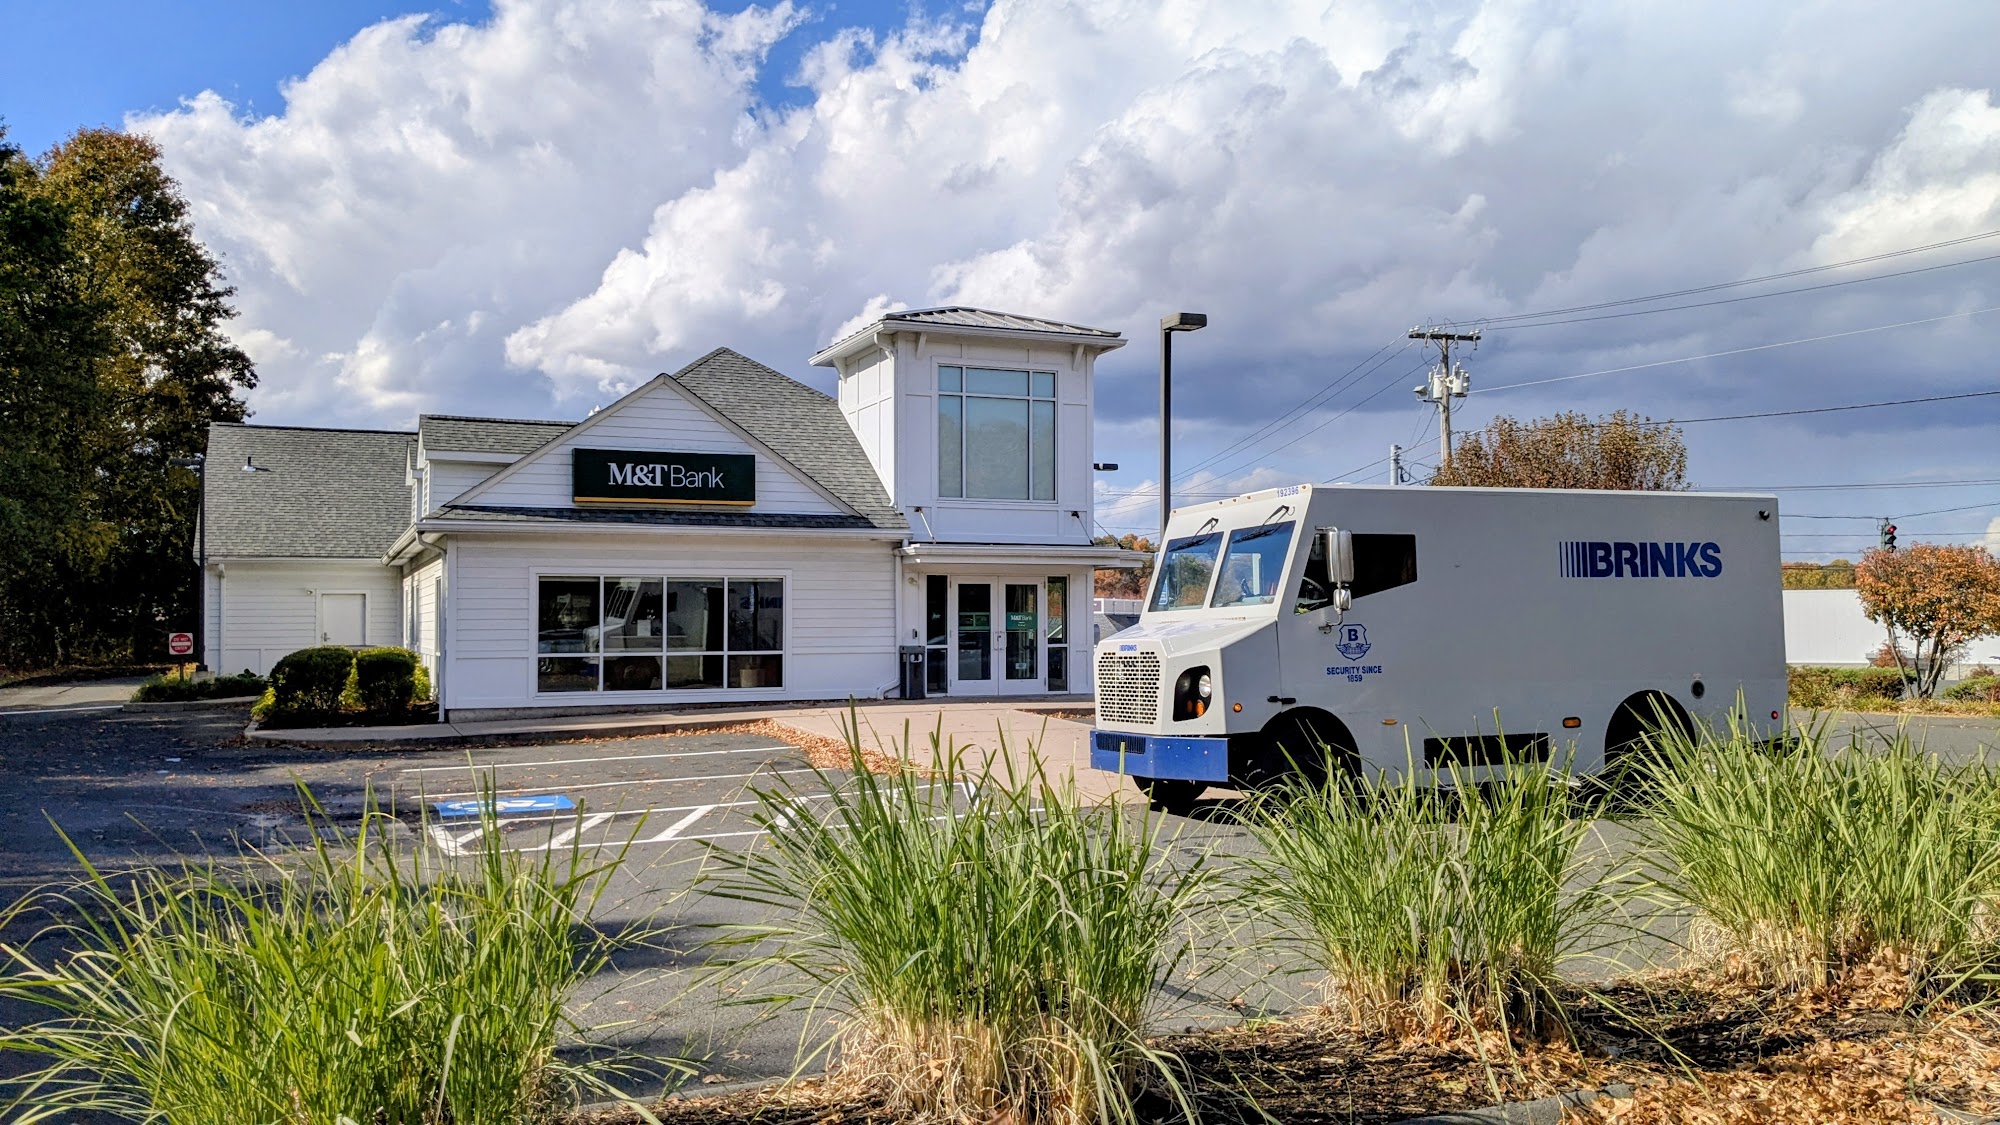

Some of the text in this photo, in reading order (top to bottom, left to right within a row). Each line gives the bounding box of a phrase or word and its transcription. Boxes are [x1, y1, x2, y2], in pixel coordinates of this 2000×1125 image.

[608, 462, 725, 489] M&T Bank
[1588, 542, 1723, 578] BRINKS
[1347, 628, 1359, 642] B
[1326, 665, 1383, 675] SECURITY SINCE
[1346, 674, 1363, 683] 1859
